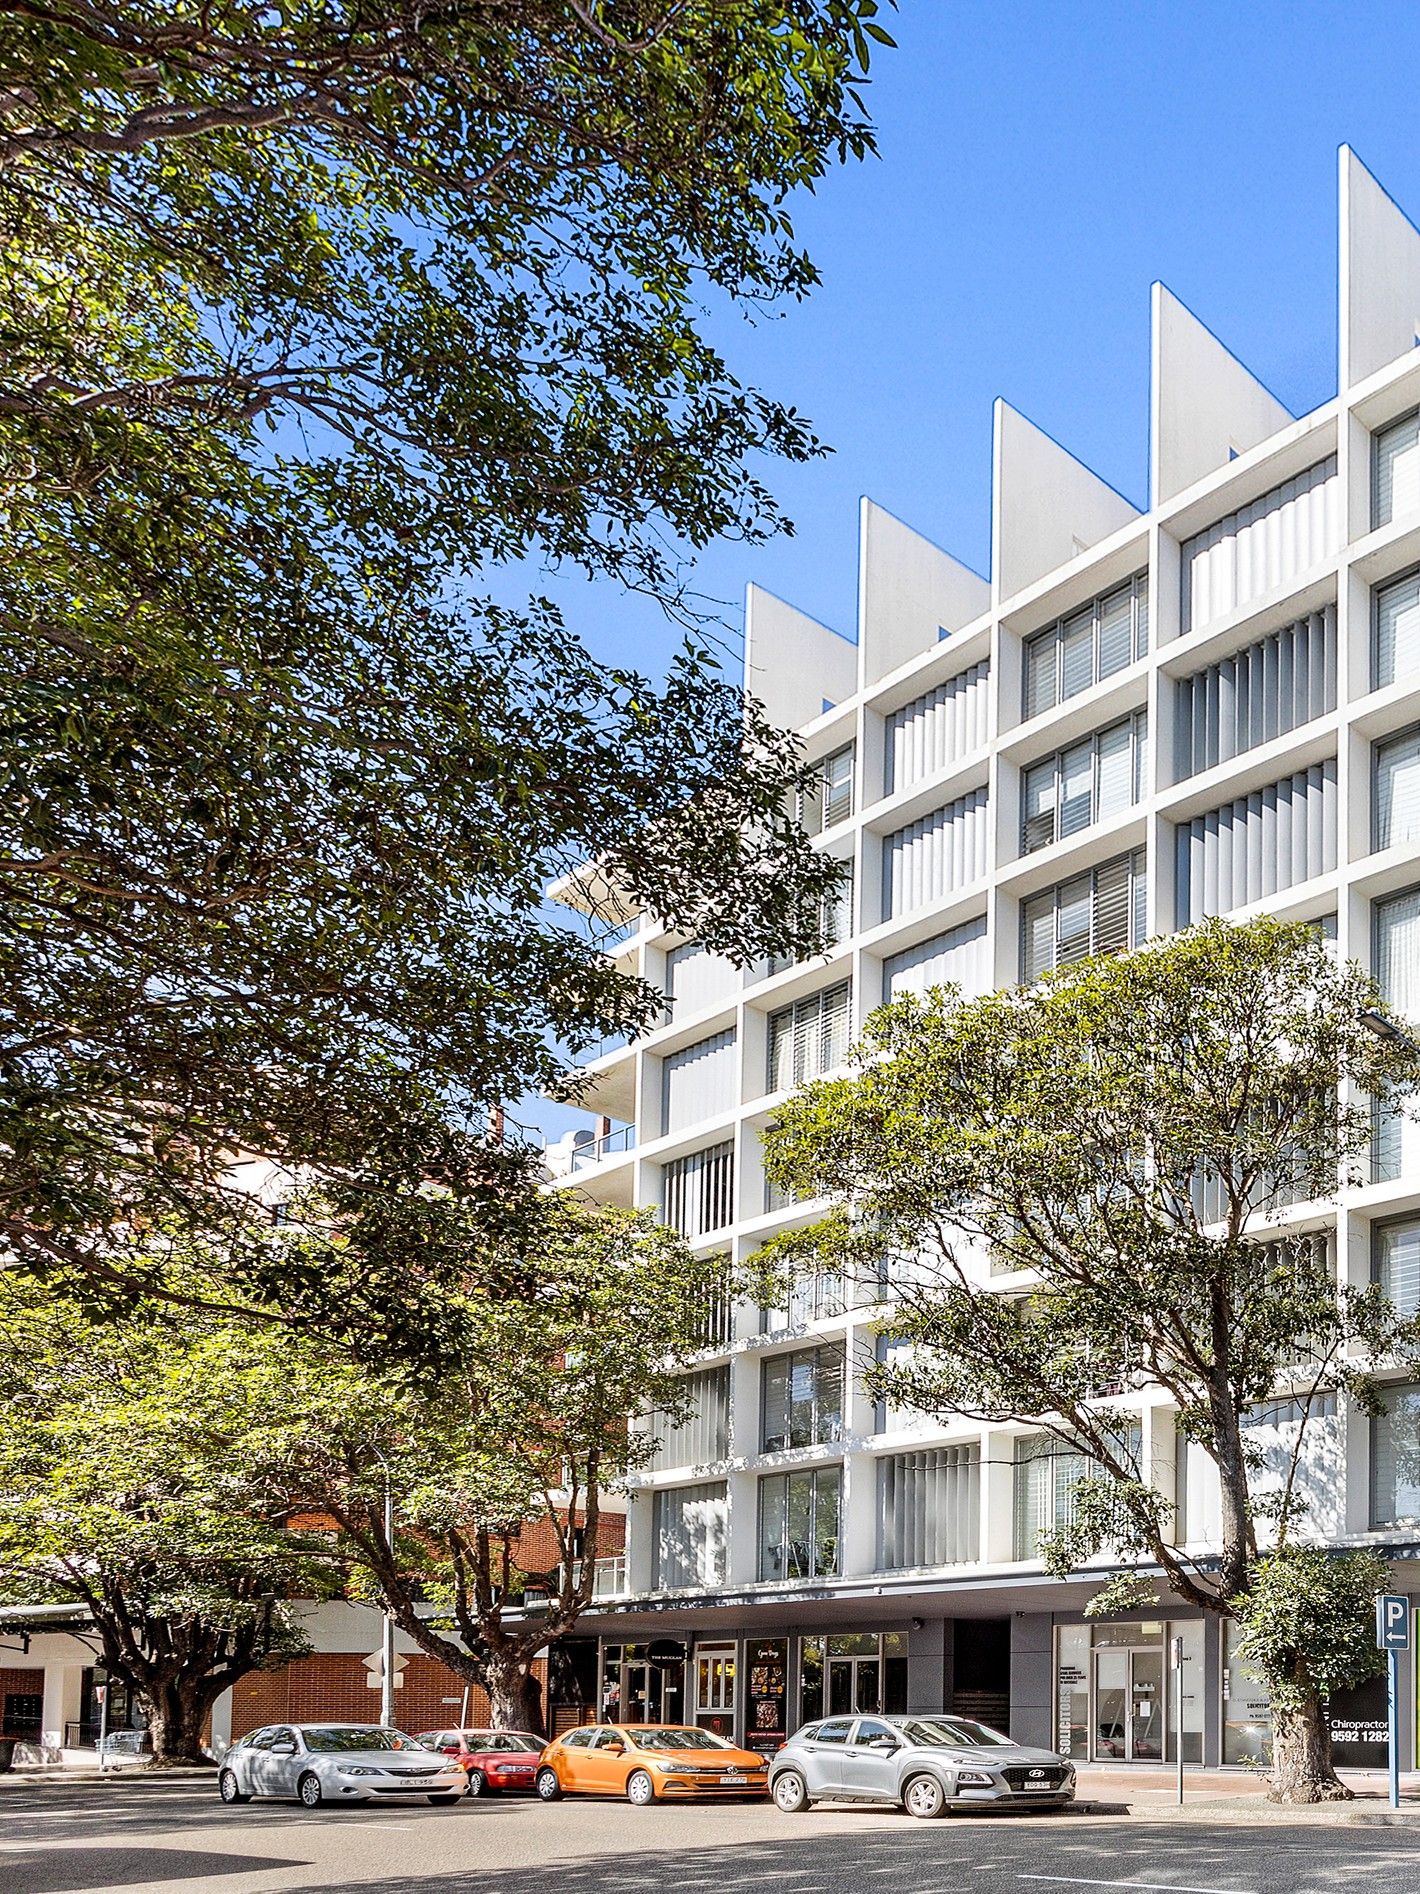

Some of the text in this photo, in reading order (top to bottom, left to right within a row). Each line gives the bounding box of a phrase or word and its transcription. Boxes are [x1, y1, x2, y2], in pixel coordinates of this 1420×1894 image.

[1387, 1602, 1404, 1628] P
[1331, 1720, 1388, 1730] Chiropractor
[1331, 1730, 1389, 1742] 9592 1282
